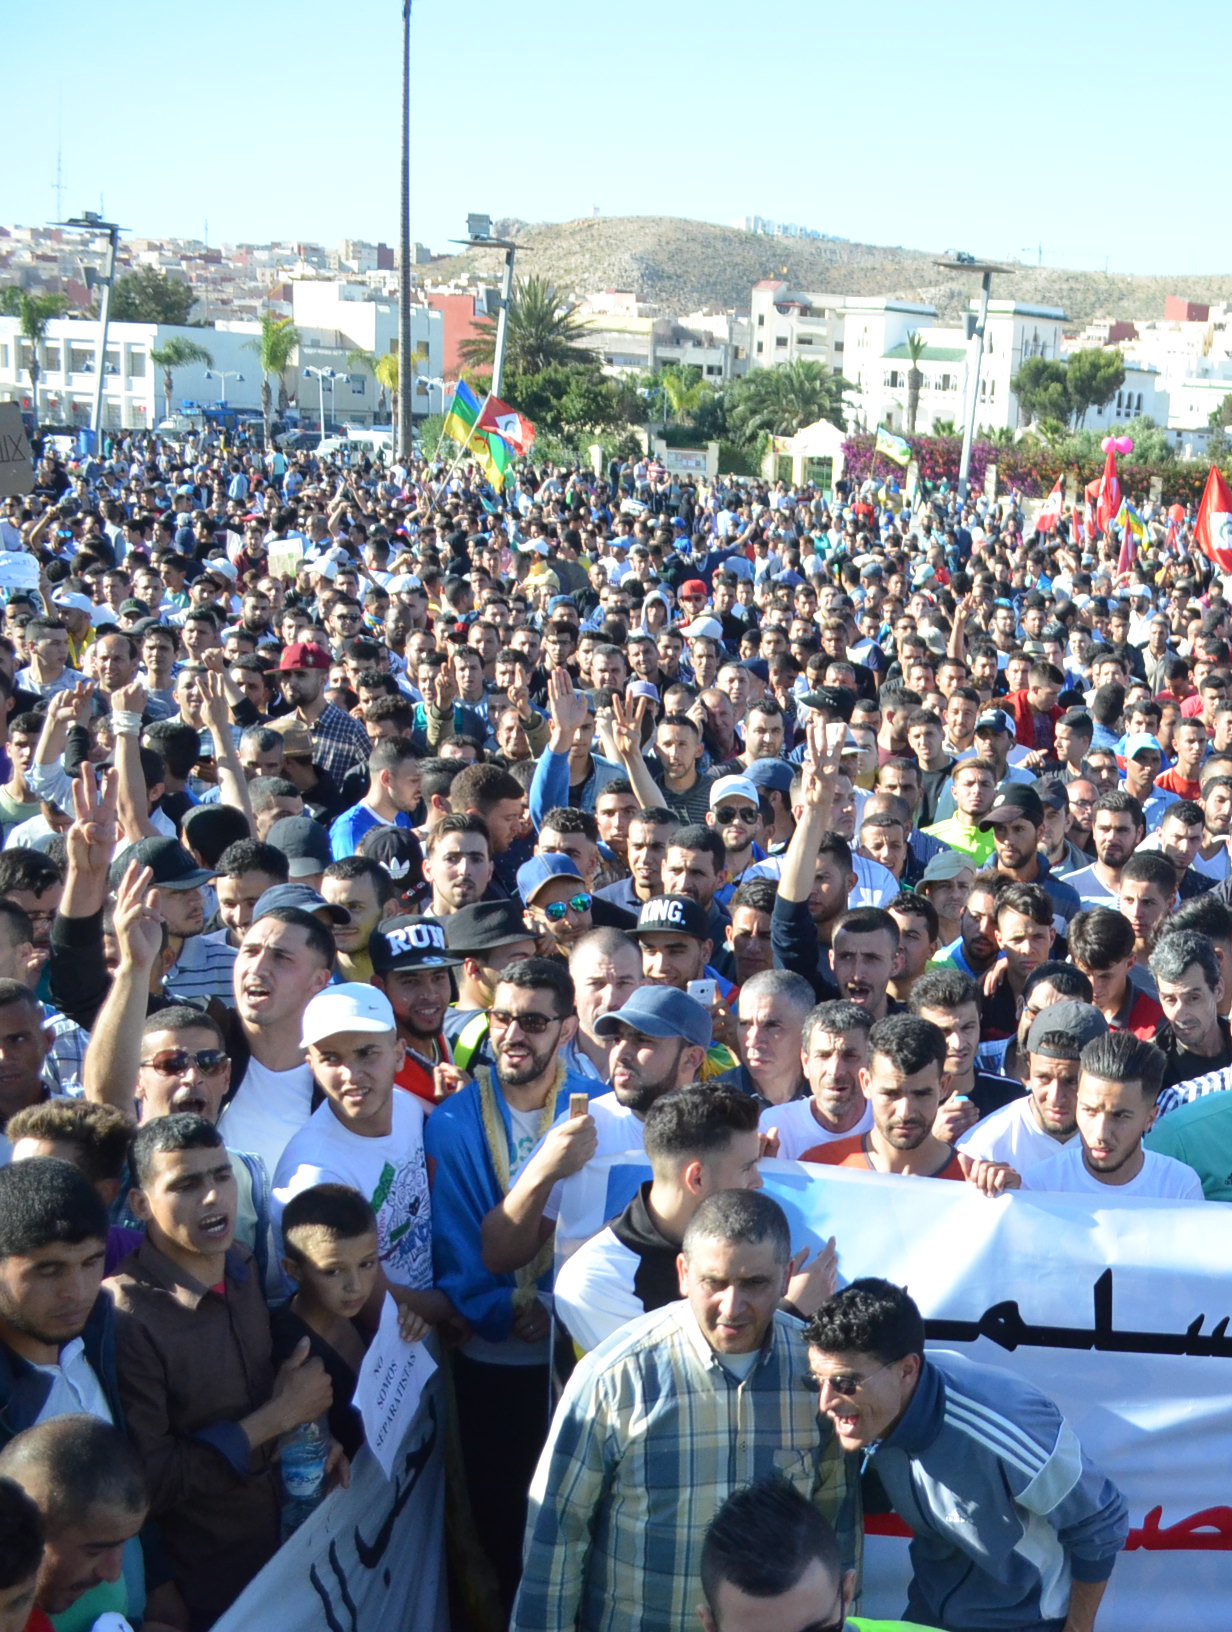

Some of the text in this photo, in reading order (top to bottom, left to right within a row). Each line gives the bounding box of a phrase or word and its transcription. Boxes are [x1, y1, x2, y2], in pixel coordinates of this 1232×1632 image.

[640, 899, 686, 925] KING.
[385, 924, 446, 956] RUN
[373, 1355, 385, 1379] NO
[376, 1359, 399, 1411] SOMOS
[376, 1350, 417, 1450] SEPARATISTAS
